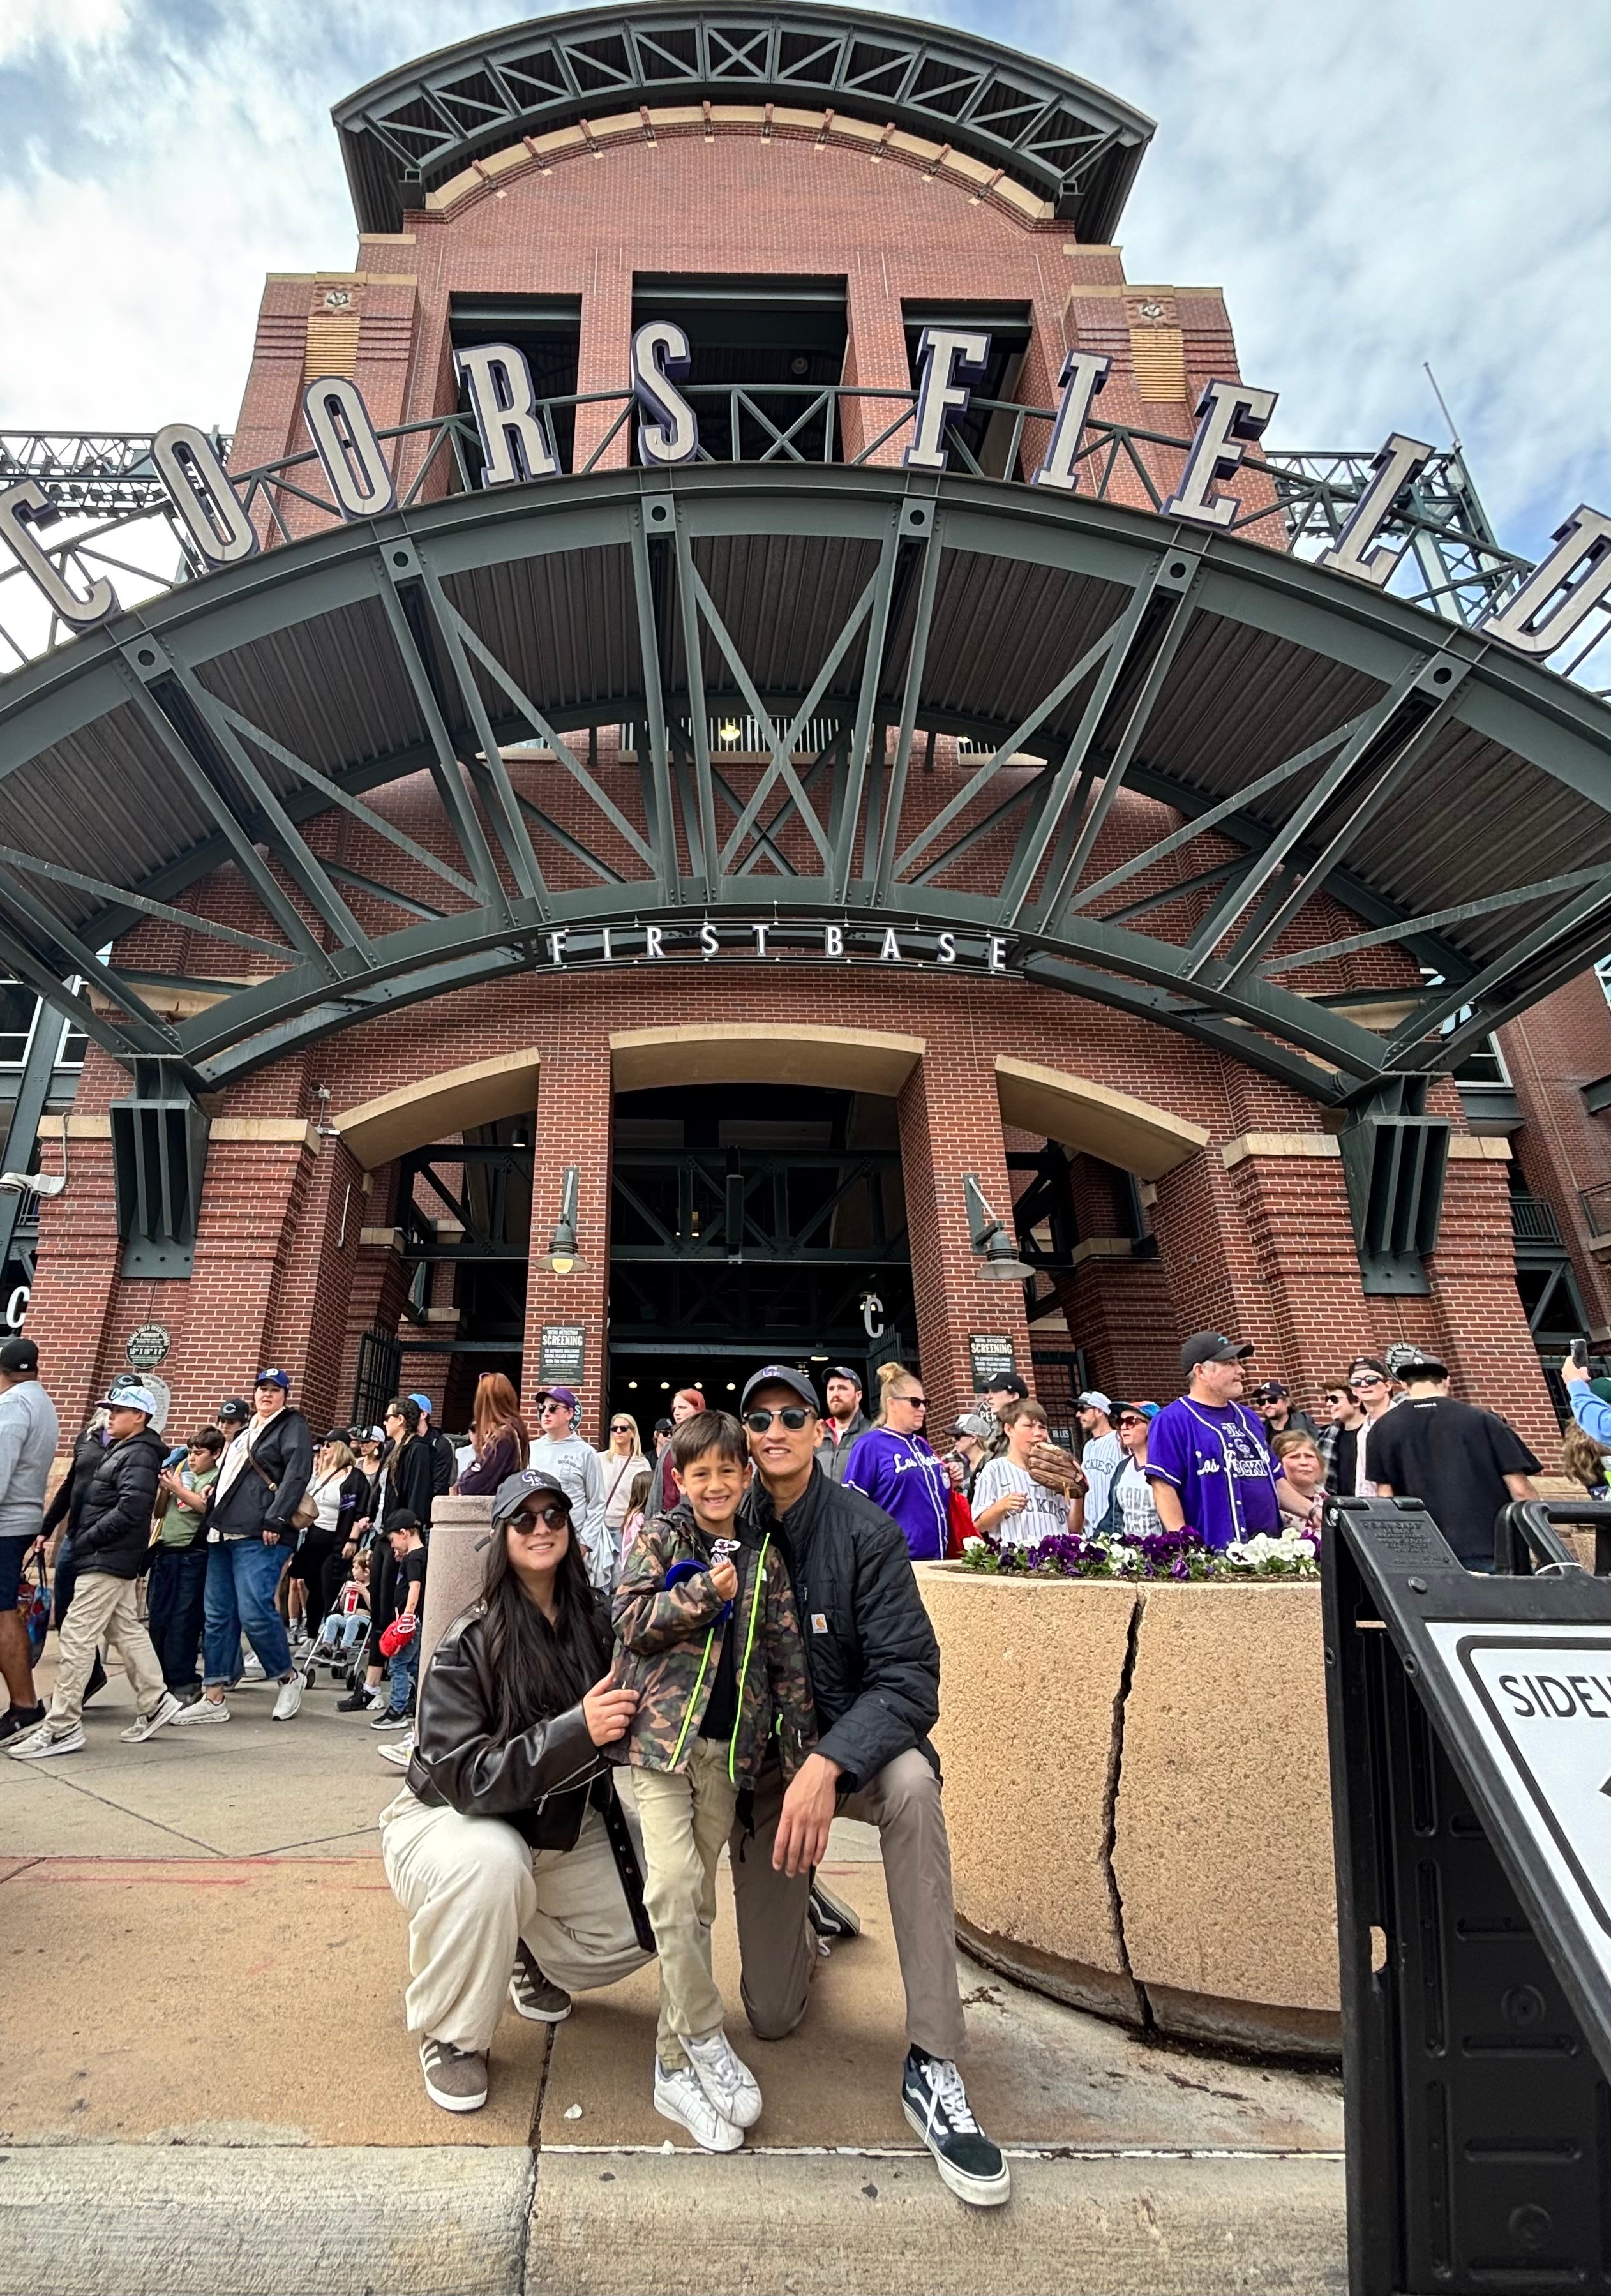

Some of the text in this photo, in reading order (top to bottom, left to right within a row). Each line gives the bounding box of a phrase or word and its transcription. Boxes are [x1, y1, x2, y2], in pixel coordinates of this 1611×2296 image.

[0, 319, 1611, 659] COORS FIELD
[551, 925, 1007, 971] FIRST BASE
[6, 1286, 31, 1328] C
[864, 1298, 884, 1339] C
[542, 1335, 583, 1346] SCREENING
[970, 1342, 1013, 1354] SCREENING
[222, 1402, 237, 1414] C
[894, 1453, 918, 1474] Los
[521, 1471, 548, 1487] CR
